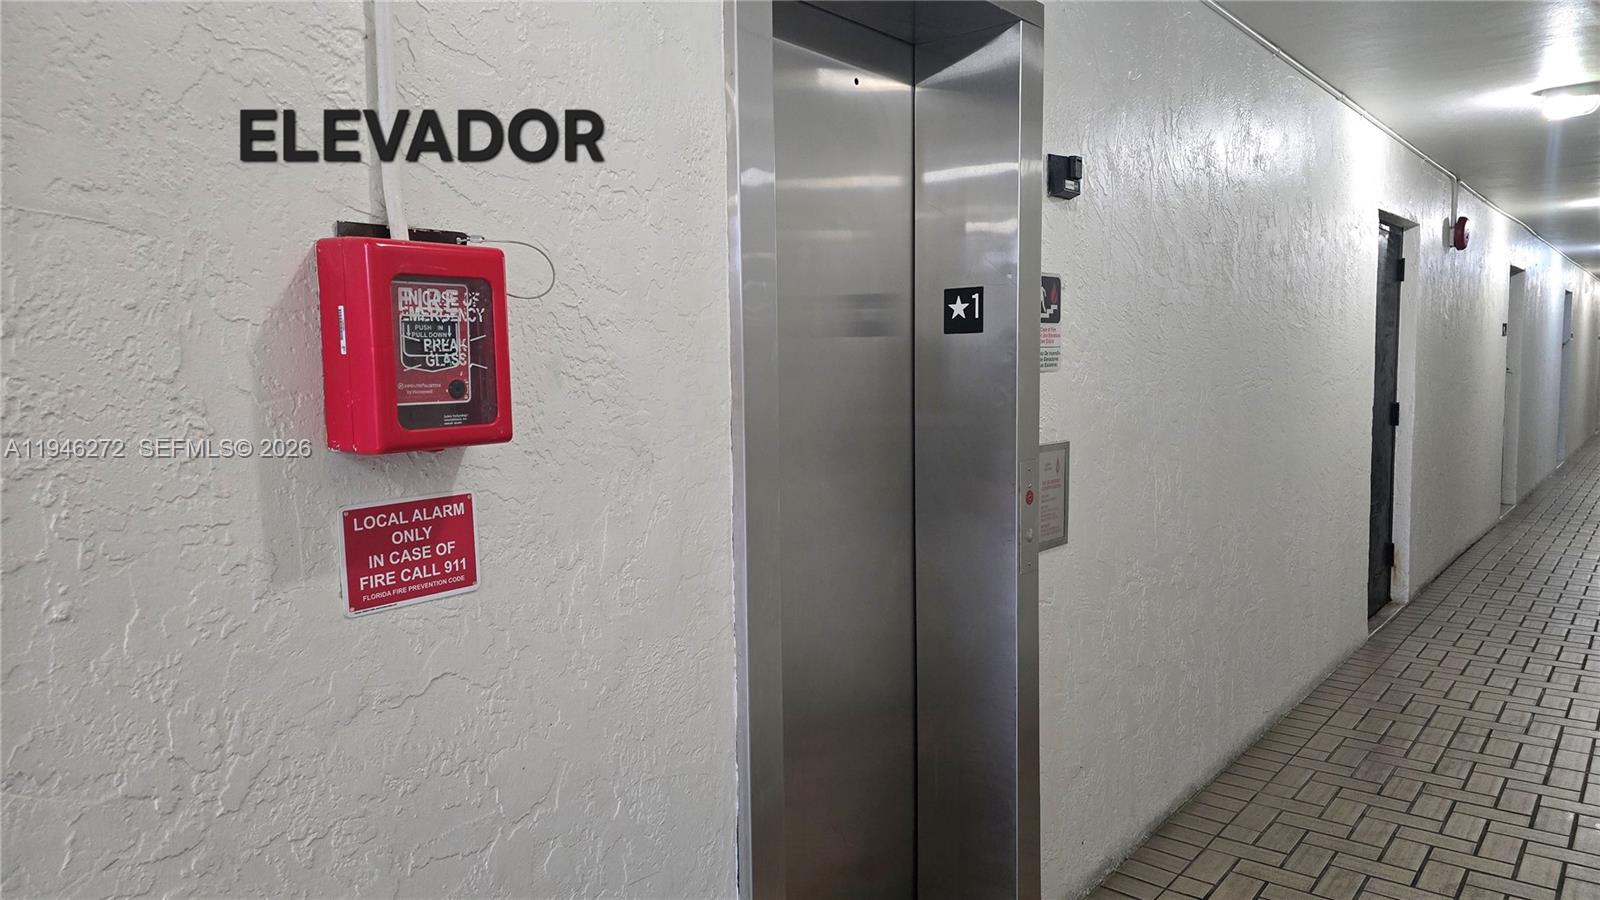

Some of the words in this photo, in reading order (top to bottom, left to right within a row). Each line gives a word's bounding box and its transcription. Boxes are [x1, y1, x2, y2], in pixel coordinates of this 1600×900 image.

[971, 292, 979, 319] 1
[425, 352, 467, 368] GLASS
[353, 511, 409, 531] LOCAL
[411, 502, 465, 522] ALARM
[391, 526, 432, 544] ONLY
[368, 553, 385, 569] IN
[389, 545, 432, 565] CASE
[435, 541, 456, 556] OF
[359, 571, 396, 591] FIRE
[400, 563, 441, 582] CALL
[444, 557, 466, 573] 911
[362, 591, 392, 602] FLORIDA
[392, 587, 408, 595] FIRE
[408, 579, 448, 592] PREVENTION
[448, 575, 465, 584] CODE
